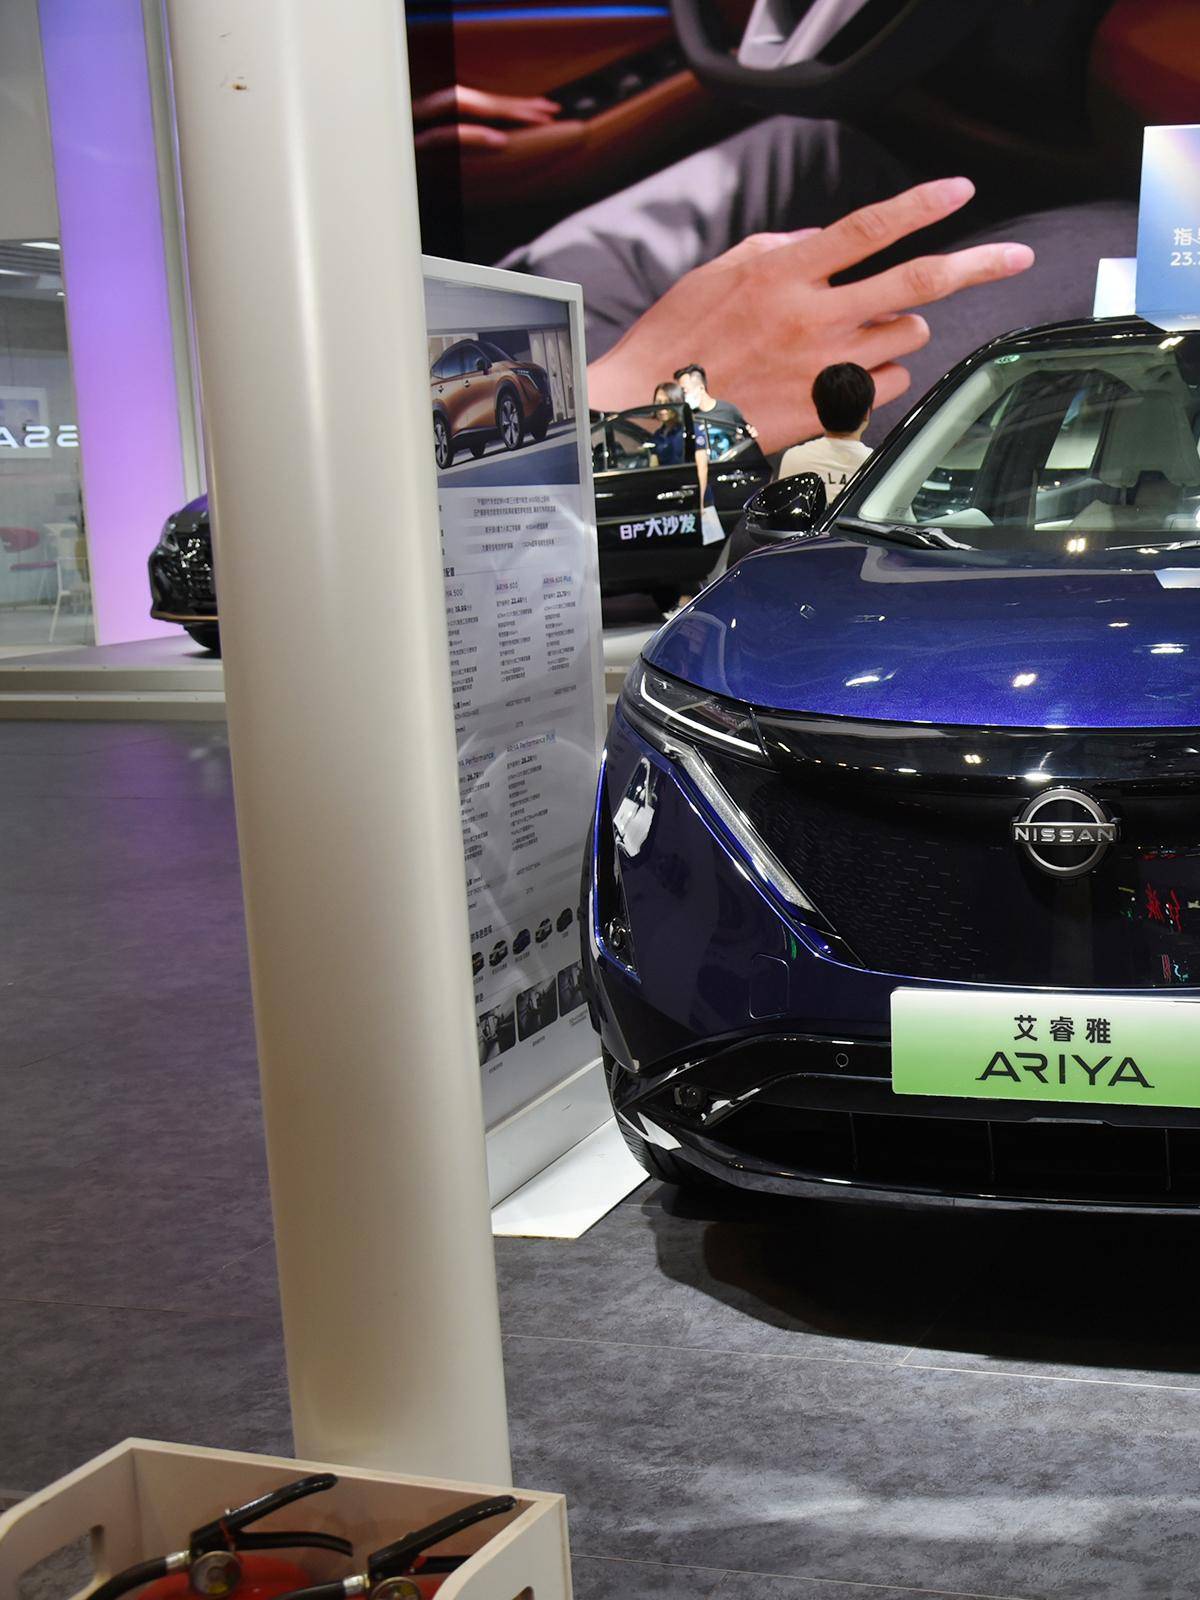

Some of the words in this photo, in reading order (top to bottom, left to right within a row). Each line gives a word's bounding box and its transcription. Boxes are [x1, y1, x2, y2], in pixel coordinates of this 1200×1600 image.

[620, 513, 697, 540] 日产大沙发
[1014, 826, 1114, 842] NISSAN
[1013, 1014, 1112, 1044] 艾睿雅
[975, 1051, 1155, 1089] ARIYA
